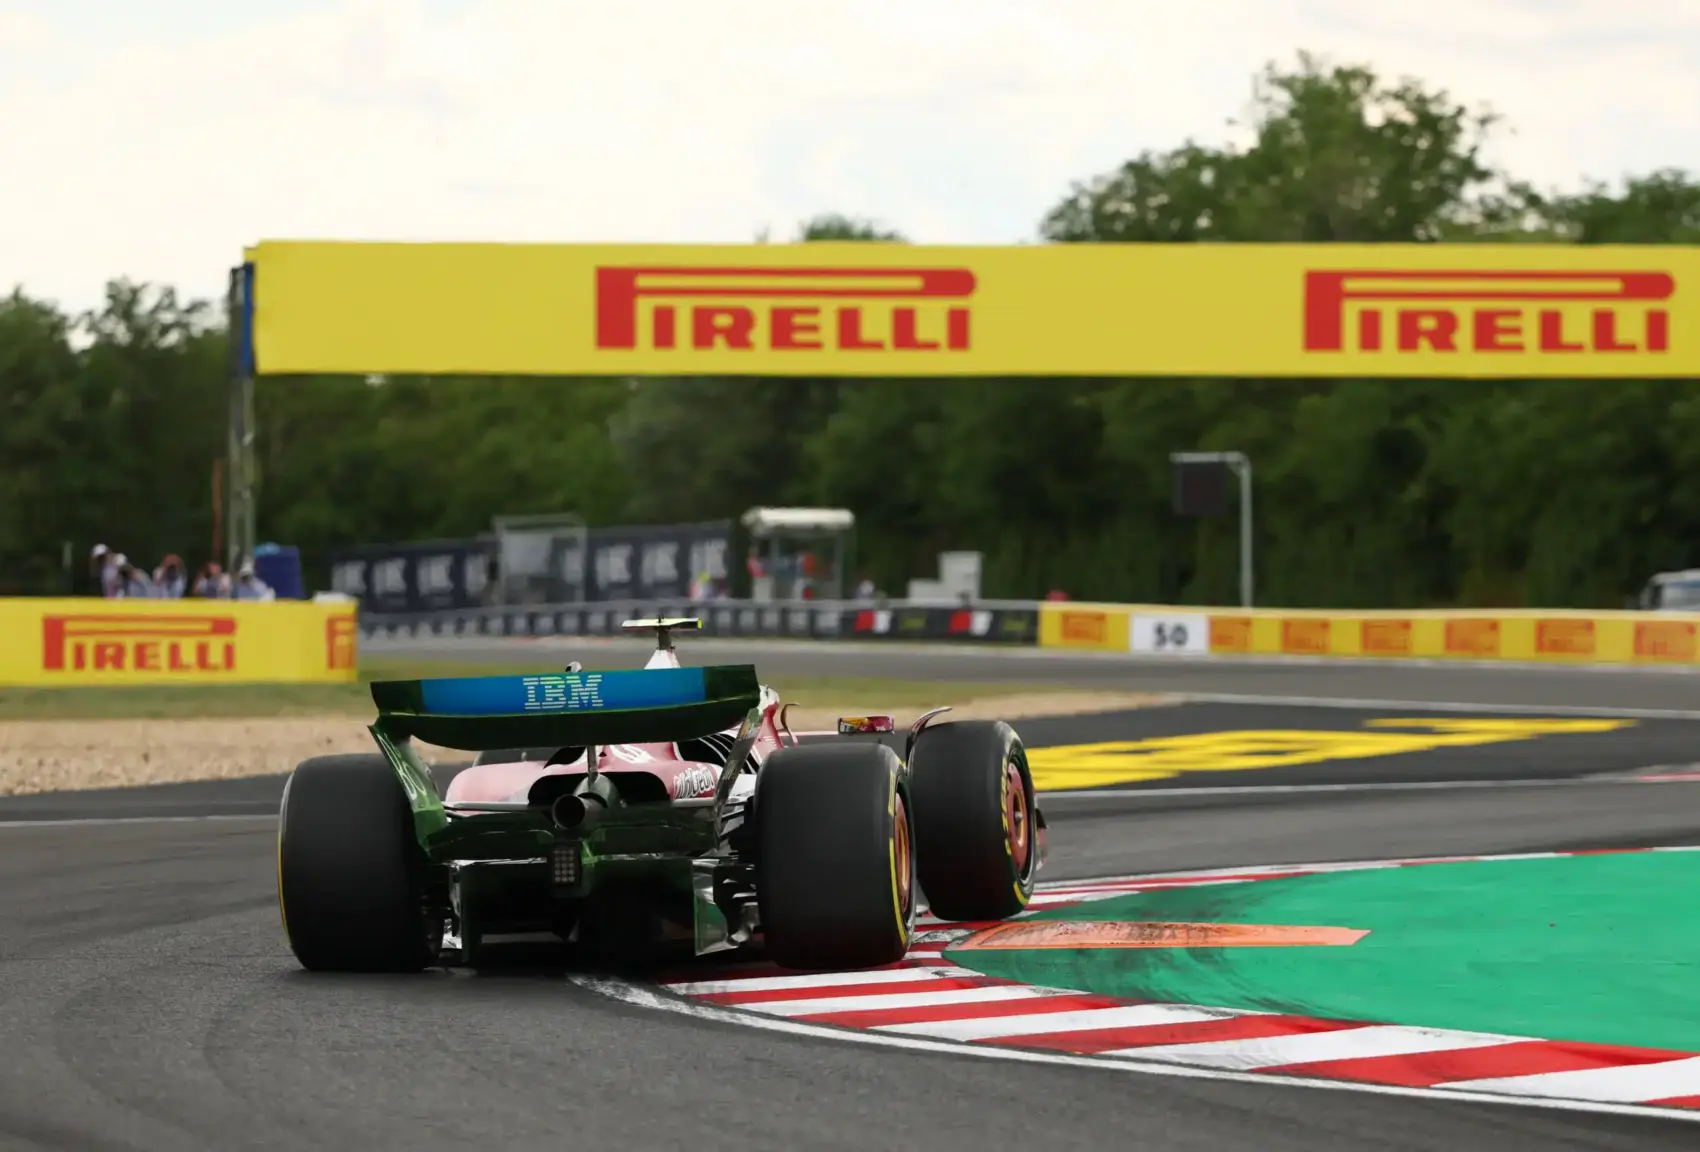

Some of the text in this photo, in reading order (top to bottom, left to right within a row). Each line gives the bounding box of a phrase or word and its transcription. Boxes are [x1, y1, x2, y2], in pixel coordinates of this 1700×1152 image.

[596, 267, 977, 351] PIRELLI
[1303, 270, 1675, 353] PIRELLI
[43, 616, 236, 671] PIRELLI
[1153, 622, 1188, 646] 50
[523, 675, 604, 709] IBM
